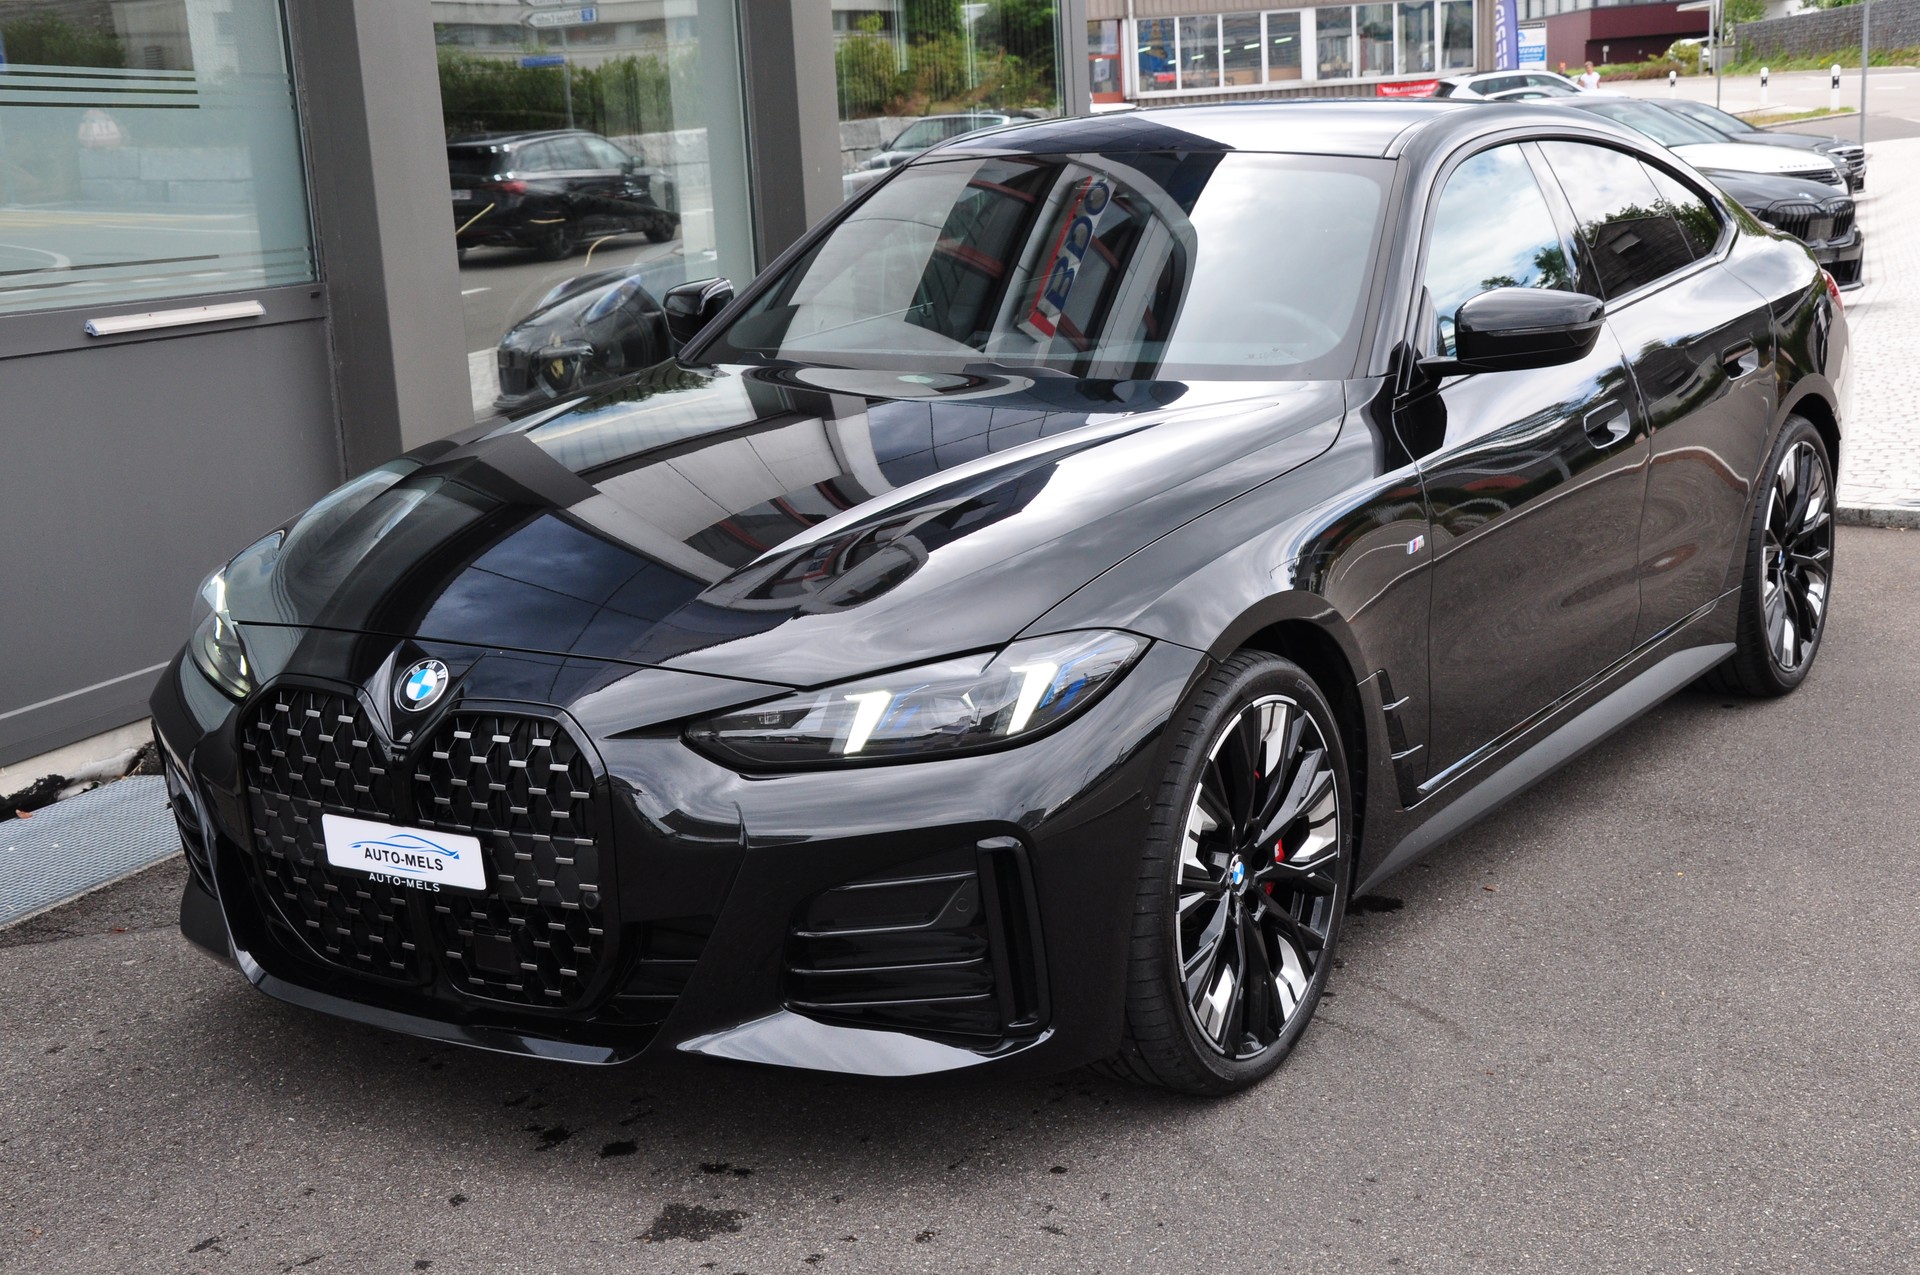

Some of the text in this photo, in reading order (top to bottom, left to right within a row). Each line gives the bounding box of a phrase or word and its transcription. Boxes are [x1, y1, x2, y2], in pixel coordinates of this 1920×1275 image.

[410, 661, 447, 679] BMW
[364, 847, 444, 871] AUTO-MELS
[368, 872, 441, 892] AUTO-MELS
